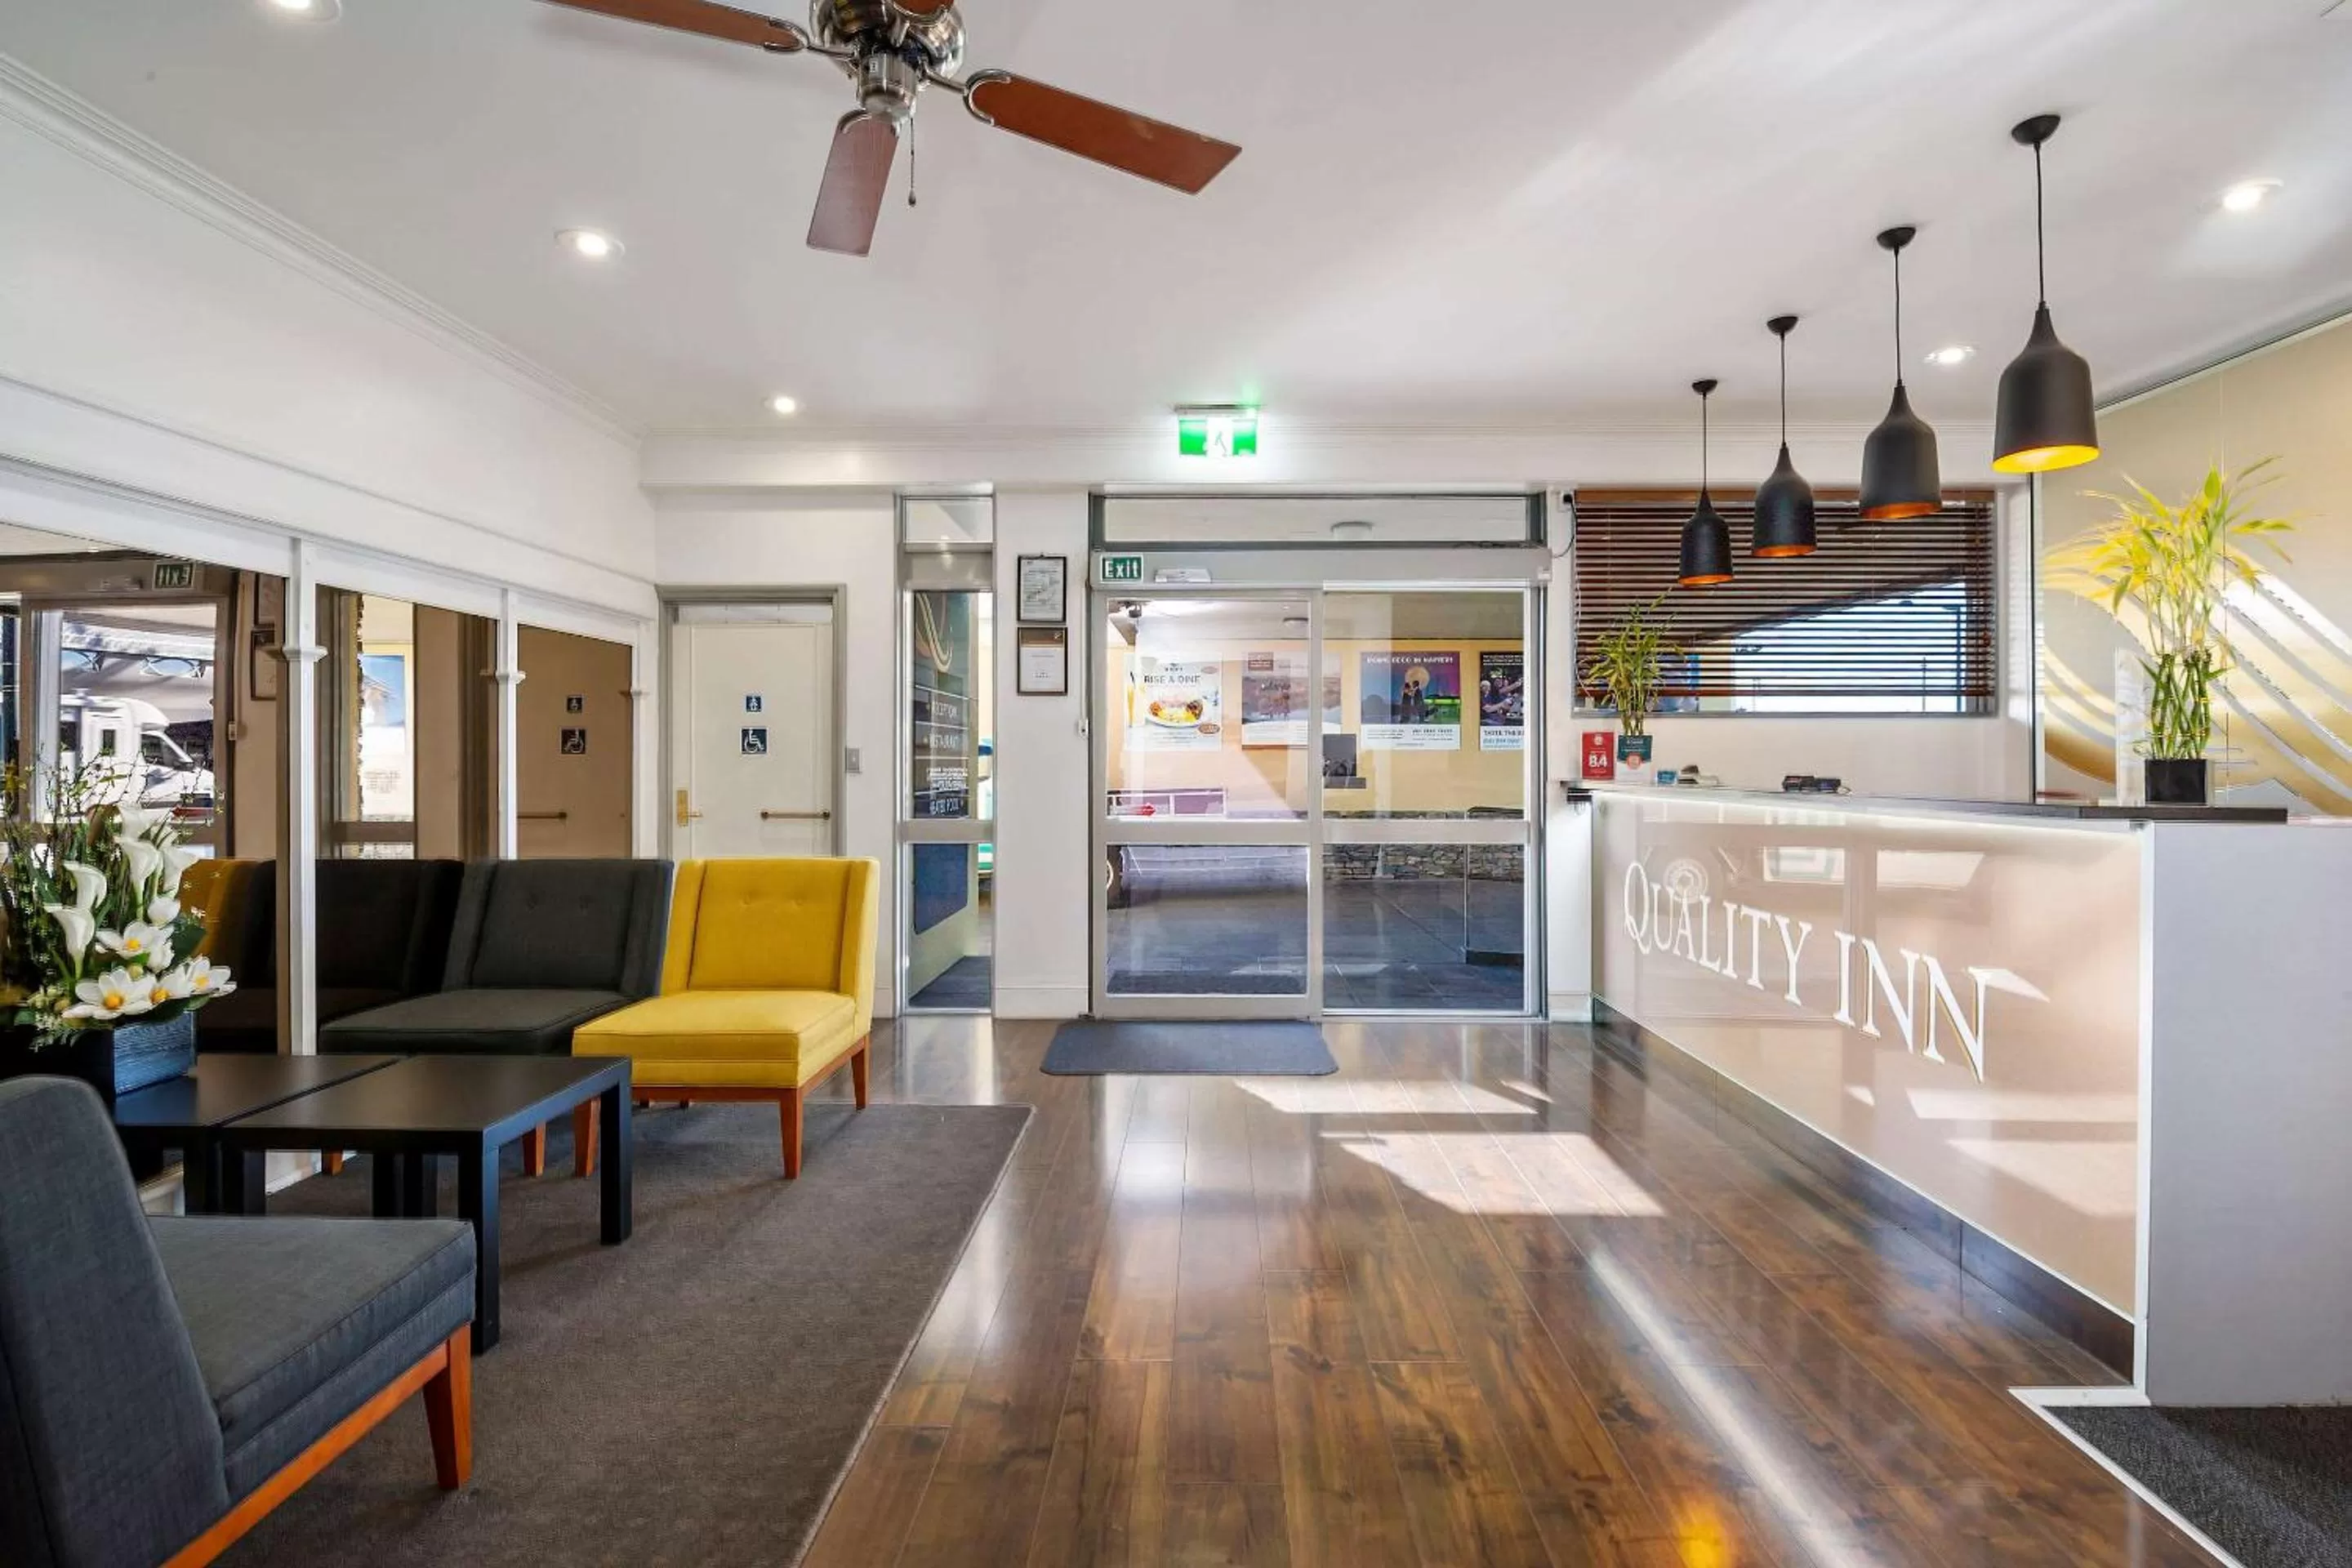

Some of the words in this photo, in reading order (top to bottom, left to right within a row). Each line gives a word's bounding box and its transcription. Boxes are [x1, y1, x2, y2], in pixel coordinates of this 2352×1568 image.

[1105, 560, 1138, 578] Exit
[1624, 862, 1812, 1007] QUALITY
[1833, 929, 1986, 1085] INN
